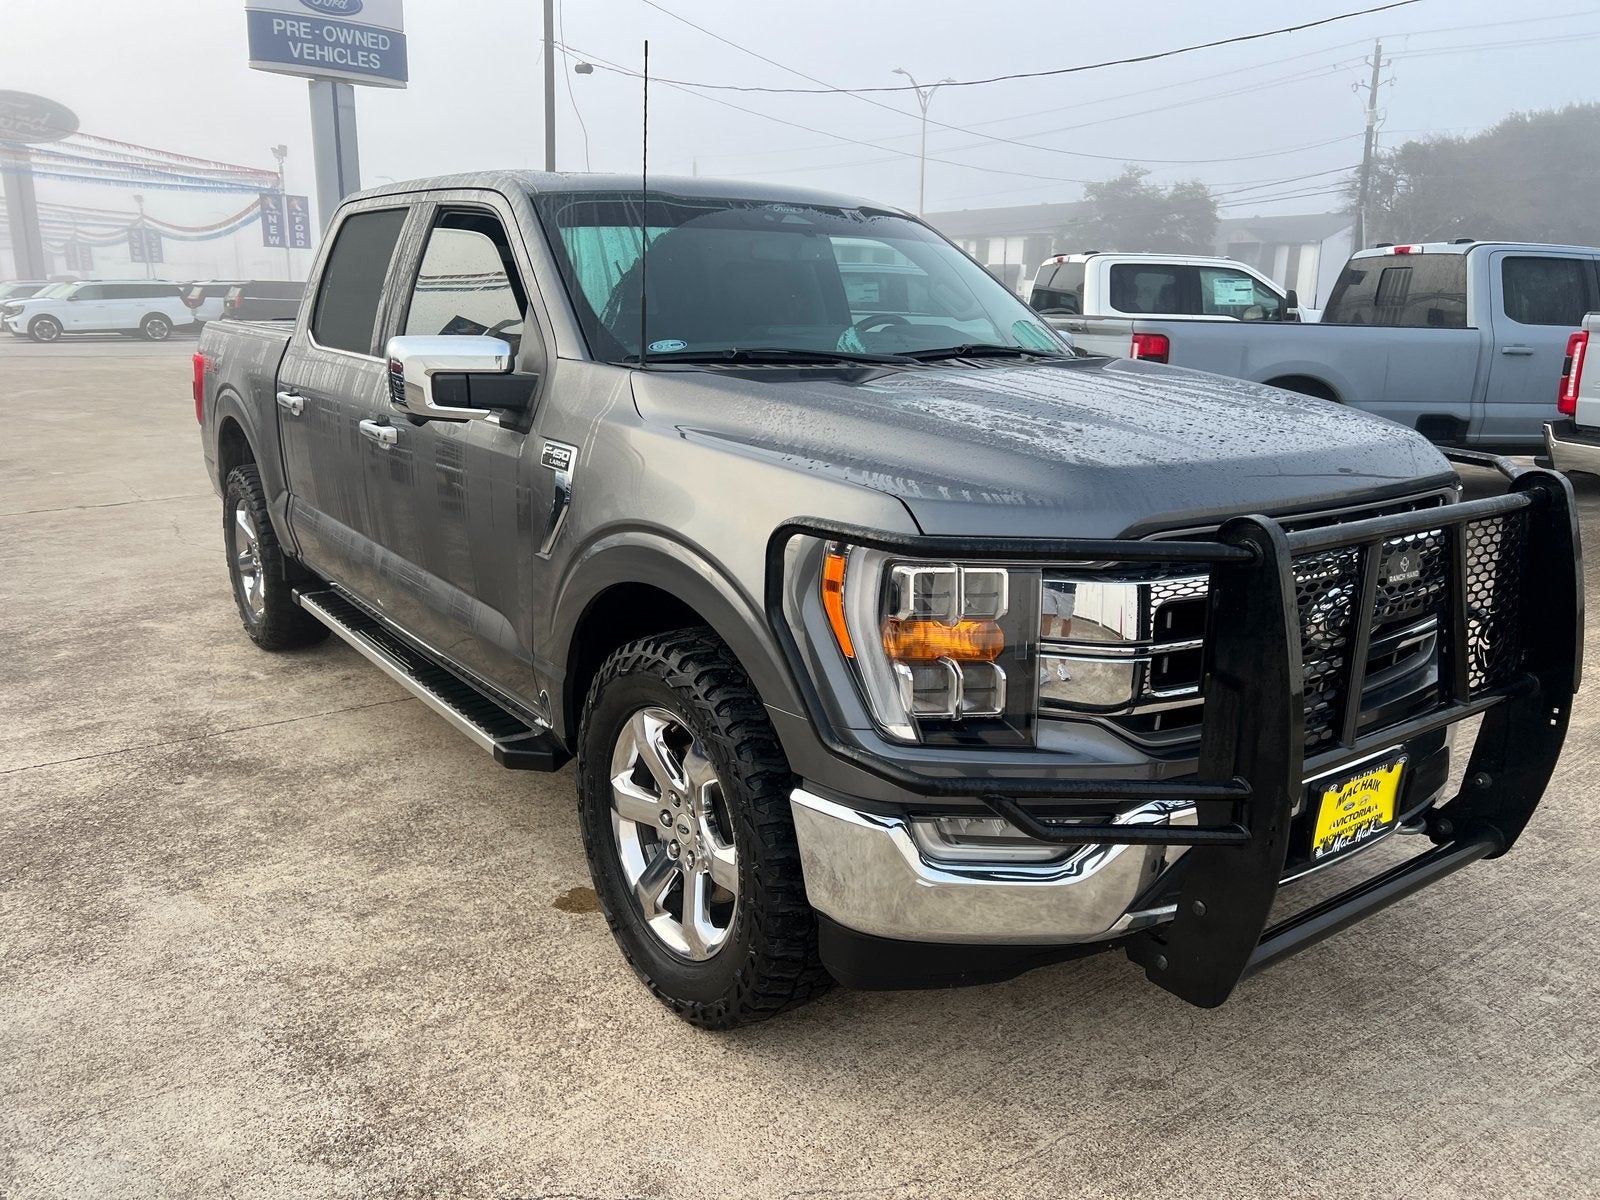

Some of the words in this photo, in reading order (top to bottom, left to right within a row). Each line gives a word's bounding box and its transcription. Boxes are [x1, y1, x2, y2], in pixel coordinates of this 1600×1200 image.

[312, 0, 348, 10] ord
[288, 41, 381, 69] VEHICLES
[267, 215, 280, 245] NEW
[294, 216, 305, 247] FORD
[543, 446, 570, 461] F-150
[1336, 783, 1360, 809] MAC
[1361, 778, 1381, 792] HAIK
